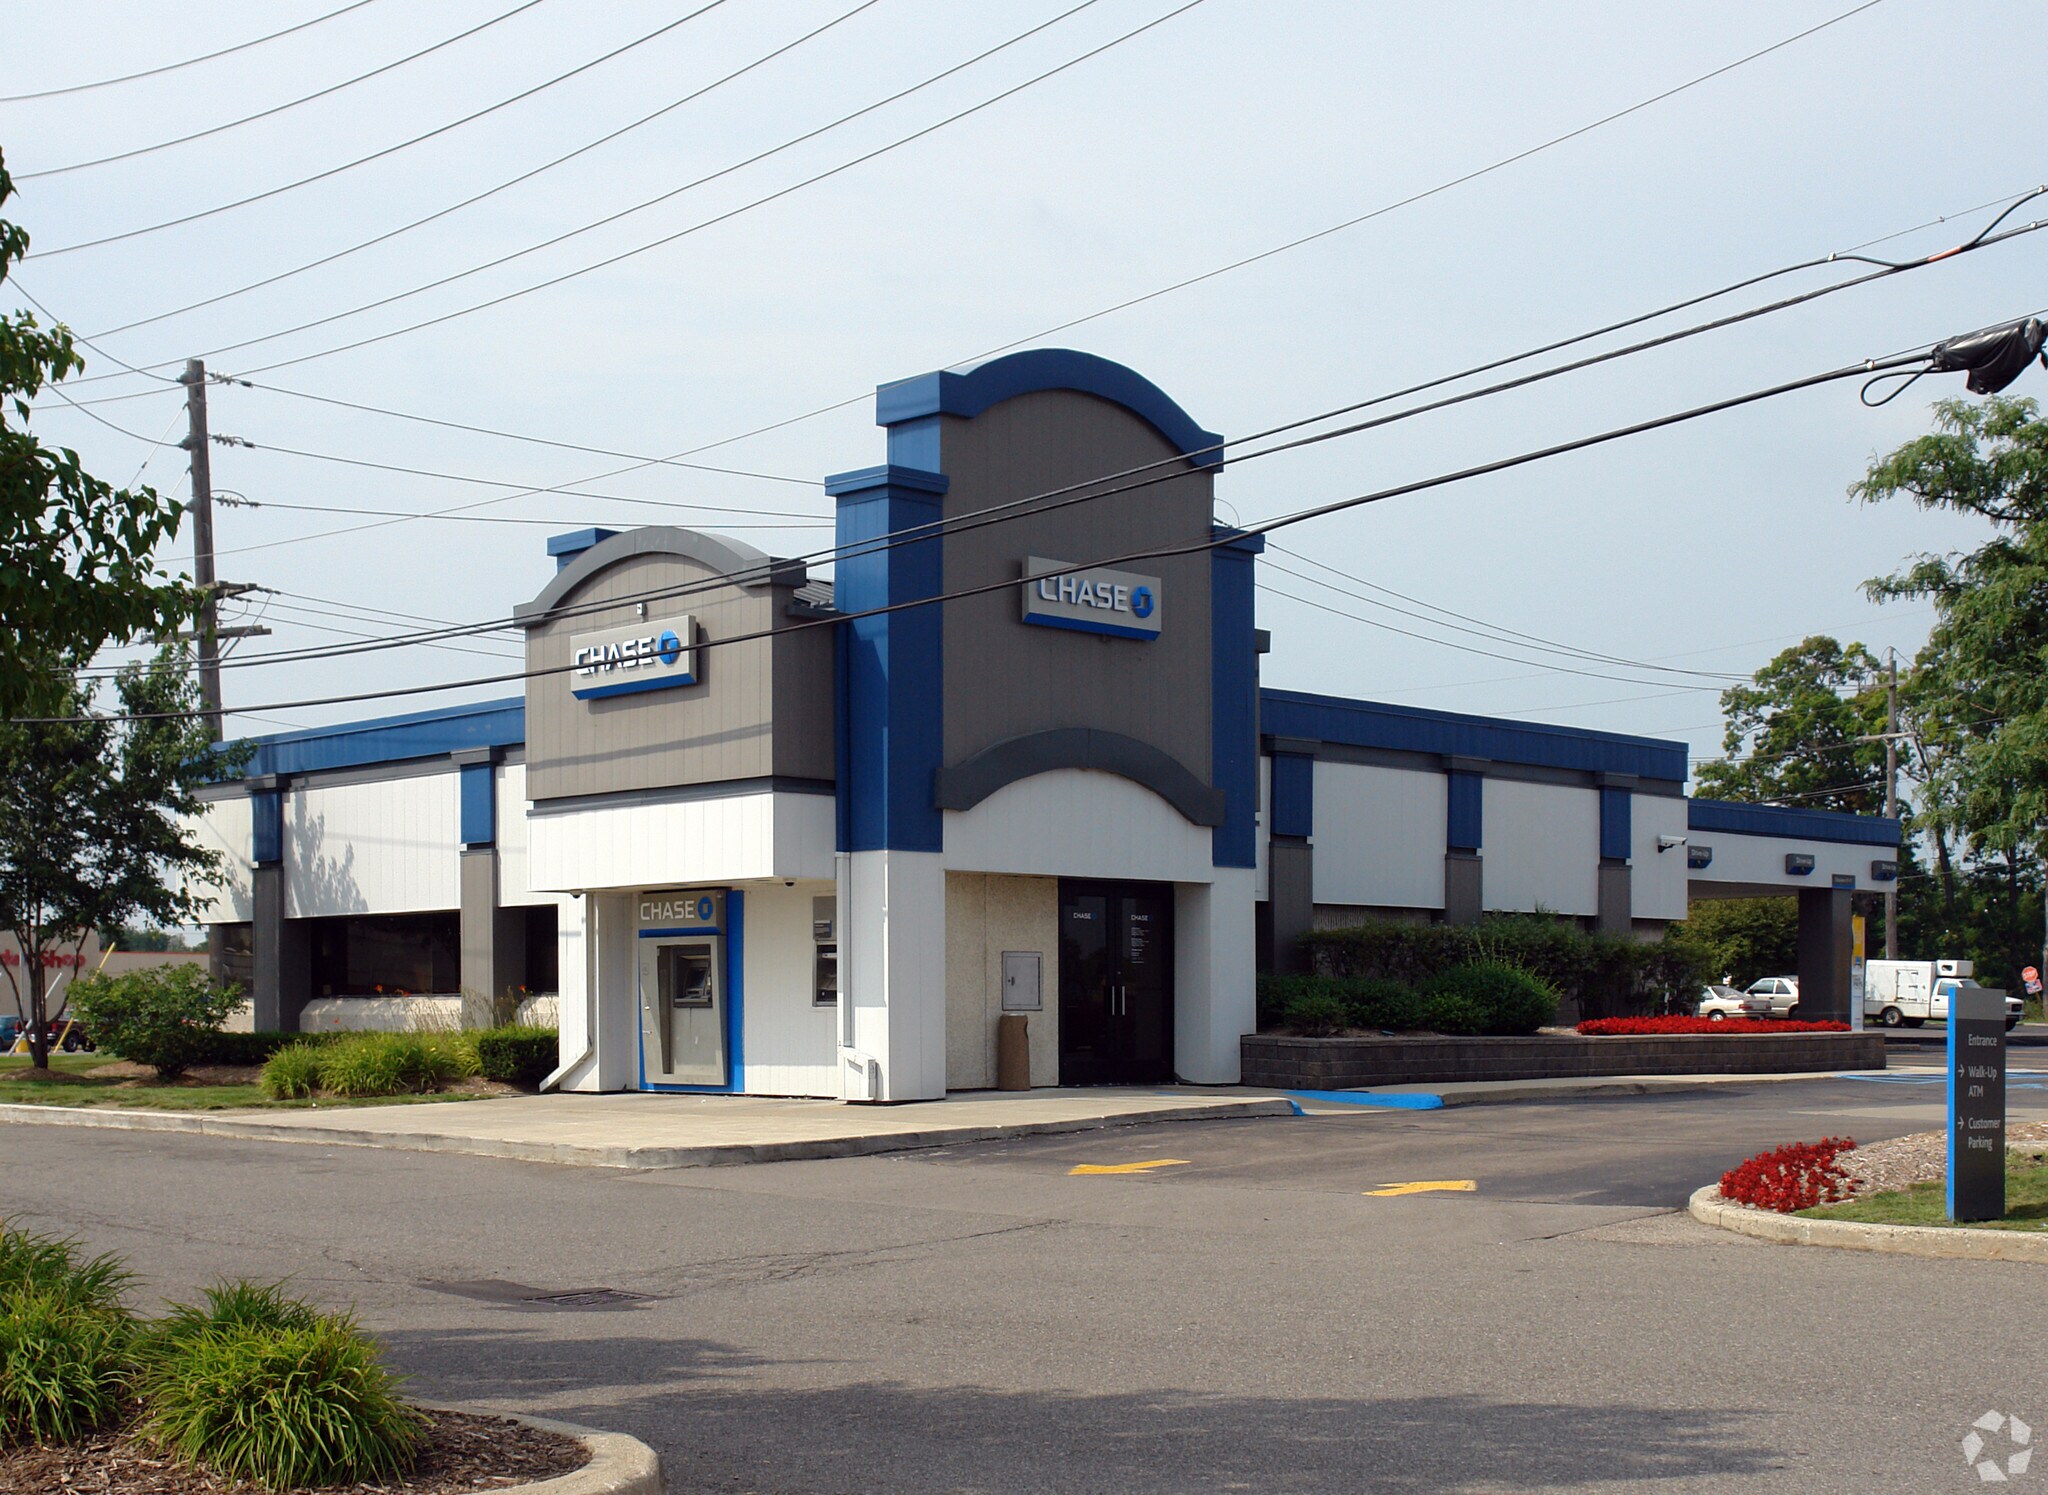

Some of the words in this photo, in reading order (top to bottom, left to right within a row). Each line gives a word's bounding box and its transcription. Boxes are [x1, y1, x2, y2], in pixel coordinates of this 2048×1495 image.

[1040, 576, 1129, 611] CHASE
[575, 637, 654, 675] CHASE
[640, 900, 695, 921] CHASE
[1073, 912, 1091, 920] CHASE
[1968, 1034, 1997, 1047] Entrance
[1968, 1066, 1997, 1081] Walk-Up
[1968, 1085, 1984, 1097] ATM
[1968, 1117, 2000, 1130] Customer
[1968, 1136, 1993, 1151] Parking
